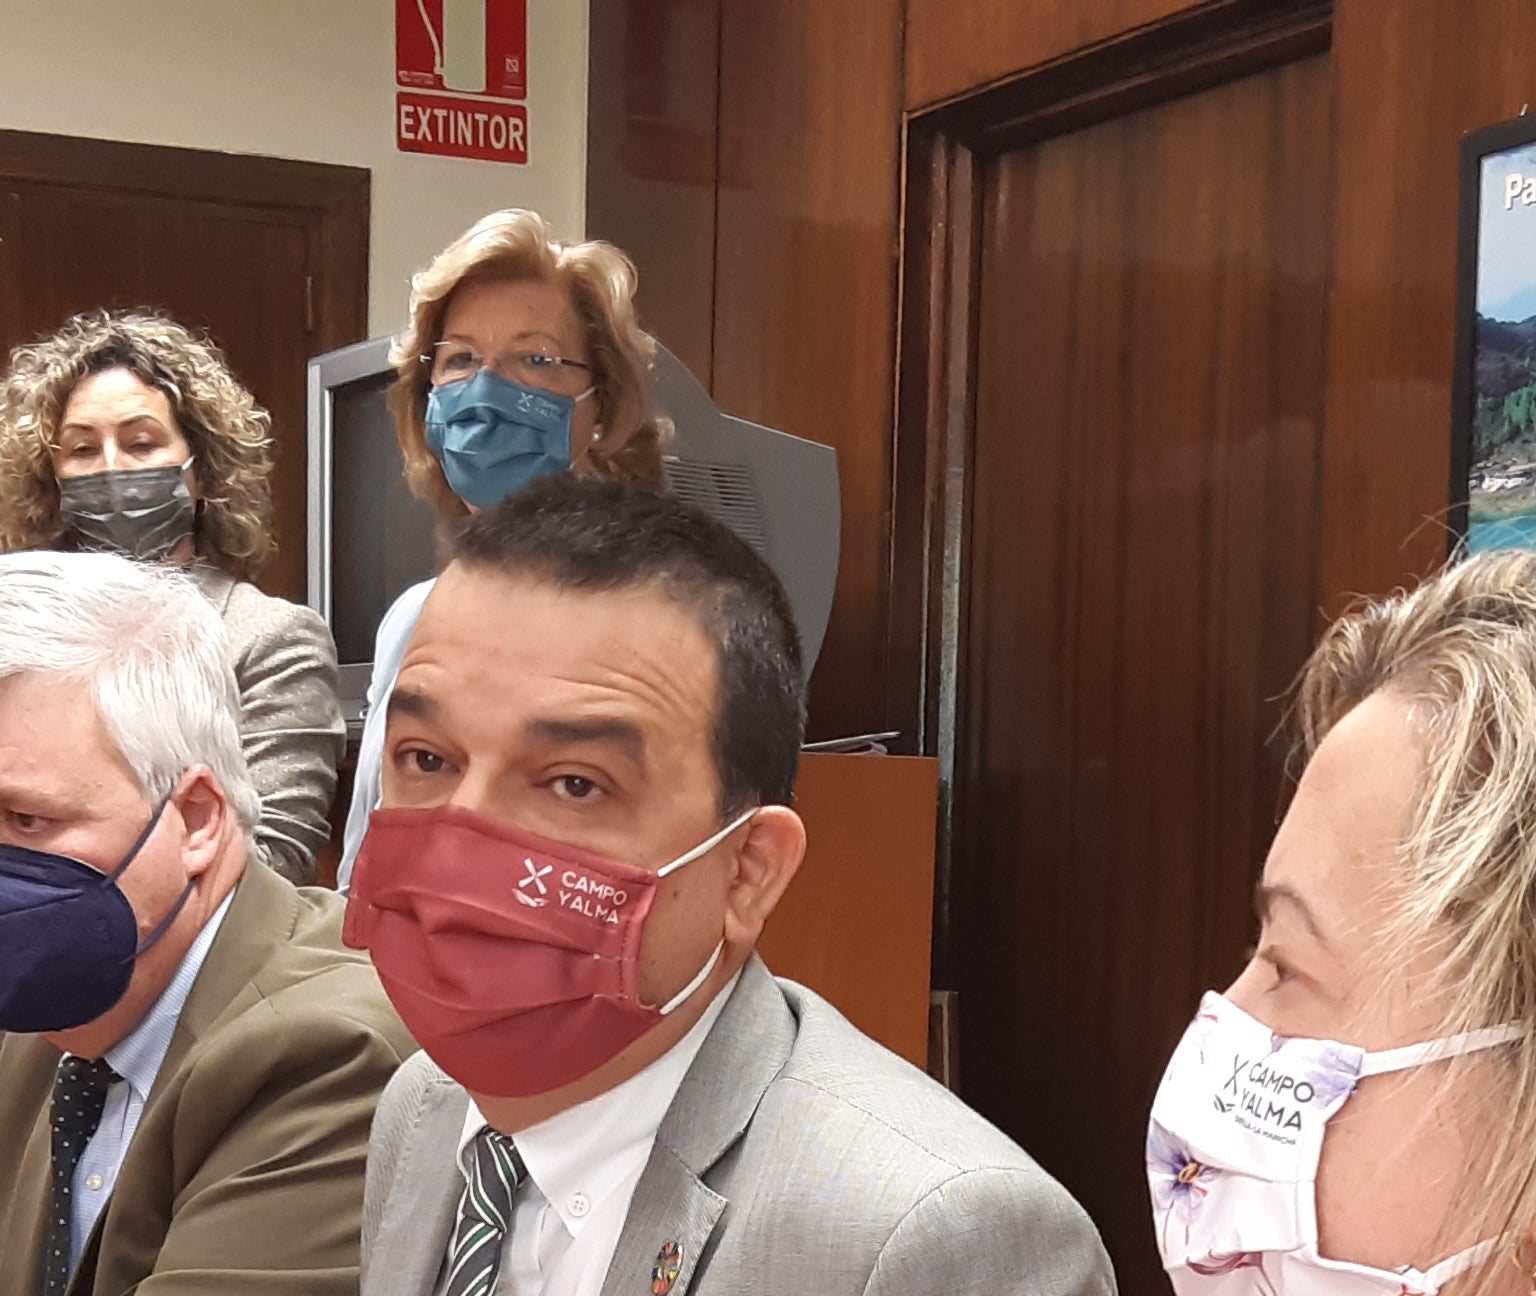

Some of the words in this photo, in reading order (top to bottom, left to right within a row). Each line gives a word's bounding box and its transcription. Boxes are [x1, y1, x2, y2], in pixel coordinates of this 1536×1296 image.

[399, 104, 526, 152] EXTINTOR
[561, 871, 628, 906] CAMPO
[1249, 1062, 1314, 1103] CAMPO
